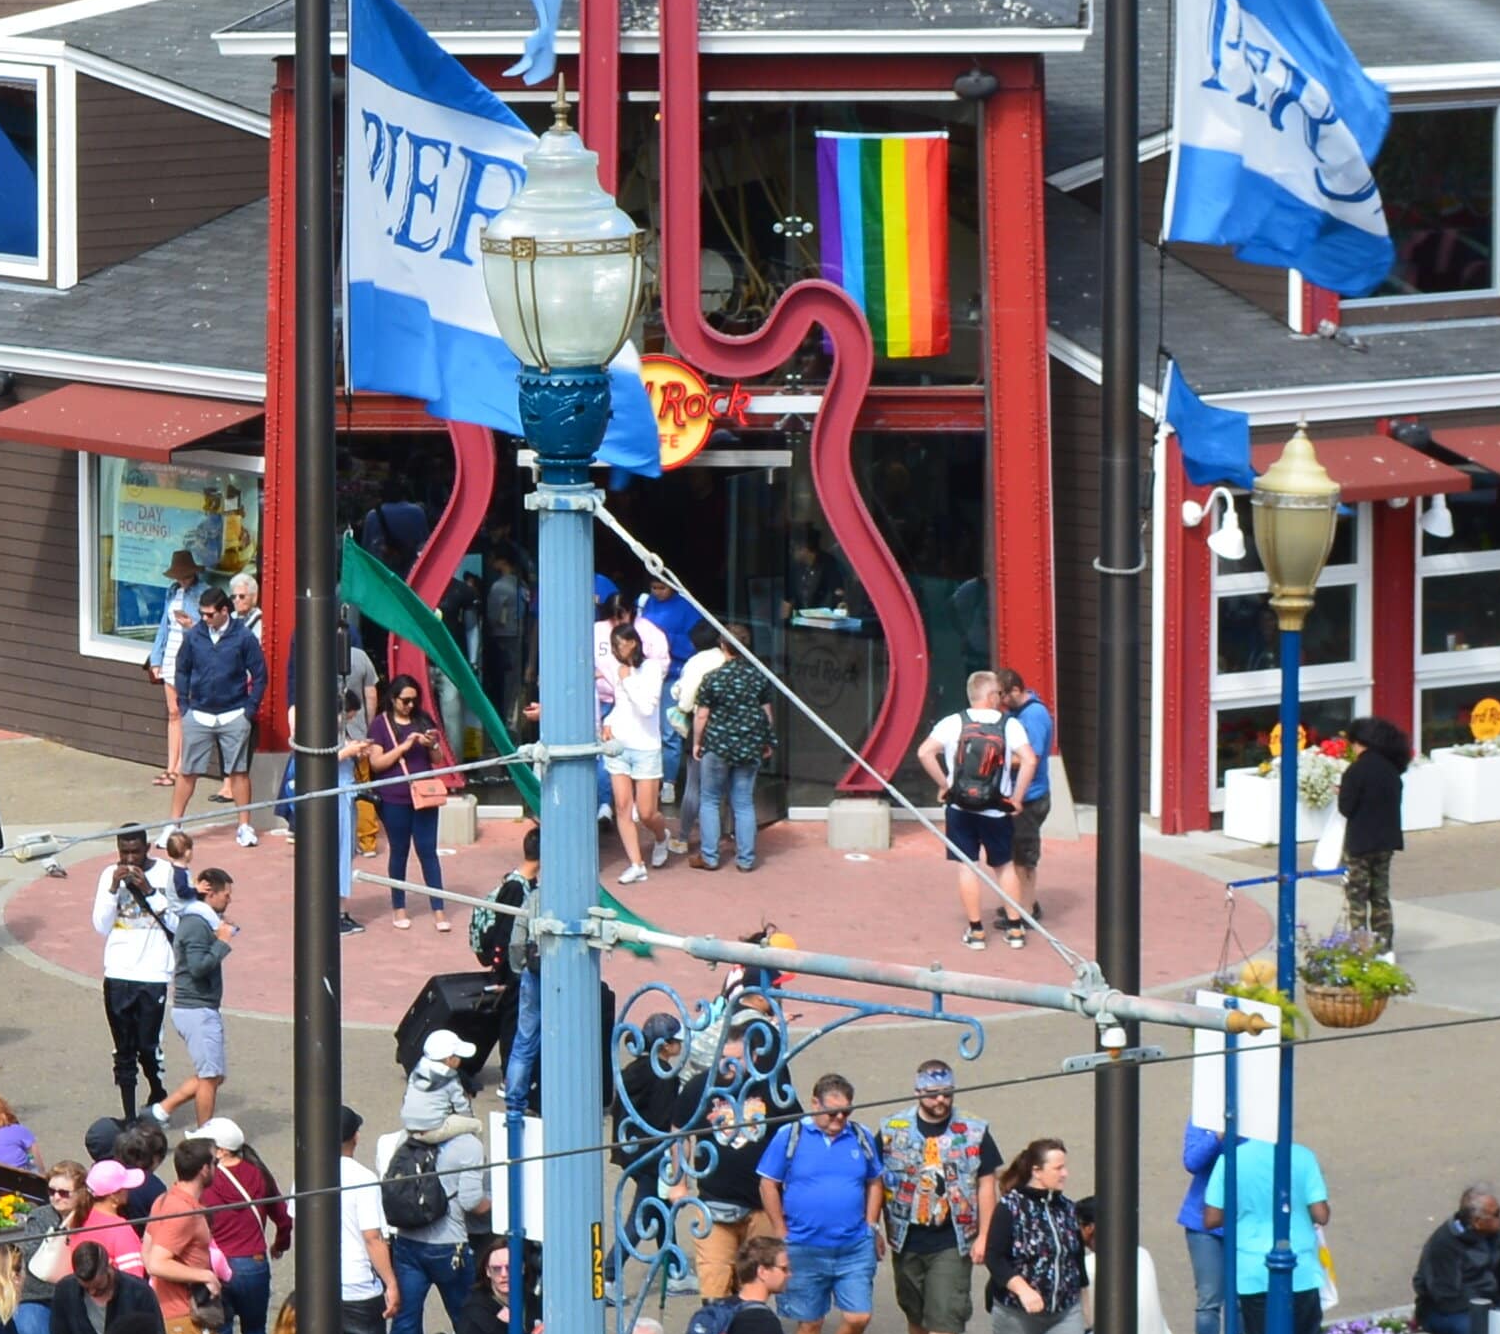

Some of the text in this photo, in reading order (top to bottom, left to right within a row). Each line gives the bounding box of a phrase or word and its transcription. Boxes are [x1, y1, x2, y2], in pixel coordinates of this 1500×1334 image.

[658, 379, 752, 427] Rock
[138, 506, 164, 523] DAY
[593, 1223, 604, 1299] 128
